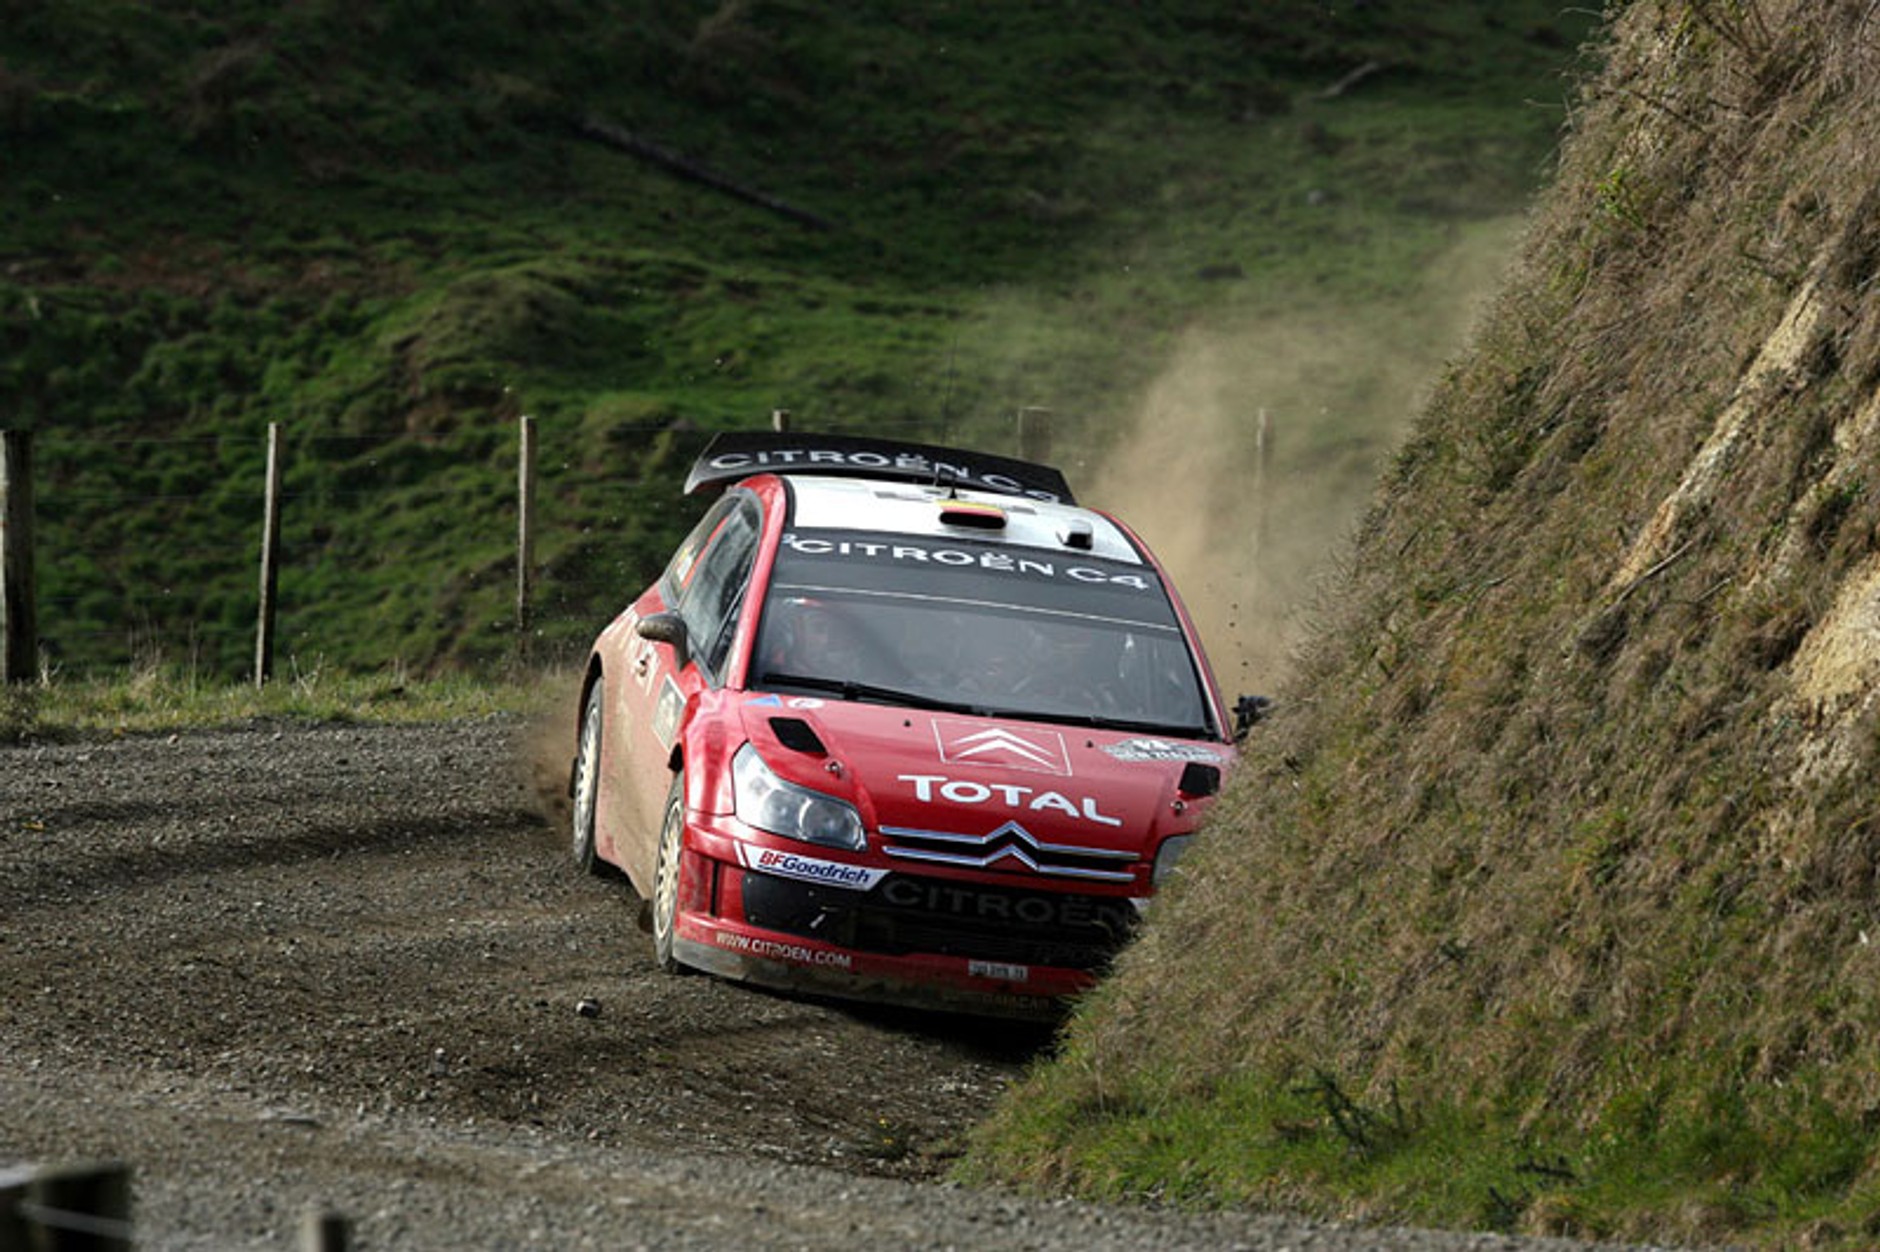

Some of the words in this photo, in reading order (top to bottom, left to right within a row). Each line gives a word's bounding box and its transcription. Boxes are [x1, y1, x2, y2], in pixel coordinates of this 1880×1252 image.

[709, 450, 970, 479] CITROËN
[793, 538, 1054, 576] CITROËN
[1065, 557, 1150, 590] C4
[897, 774, 1122, 827] TOTAL
[758, 849, 872, 885] BFGoodrich
[715, 931, 852, 968] WWW.CITROEN.COM
